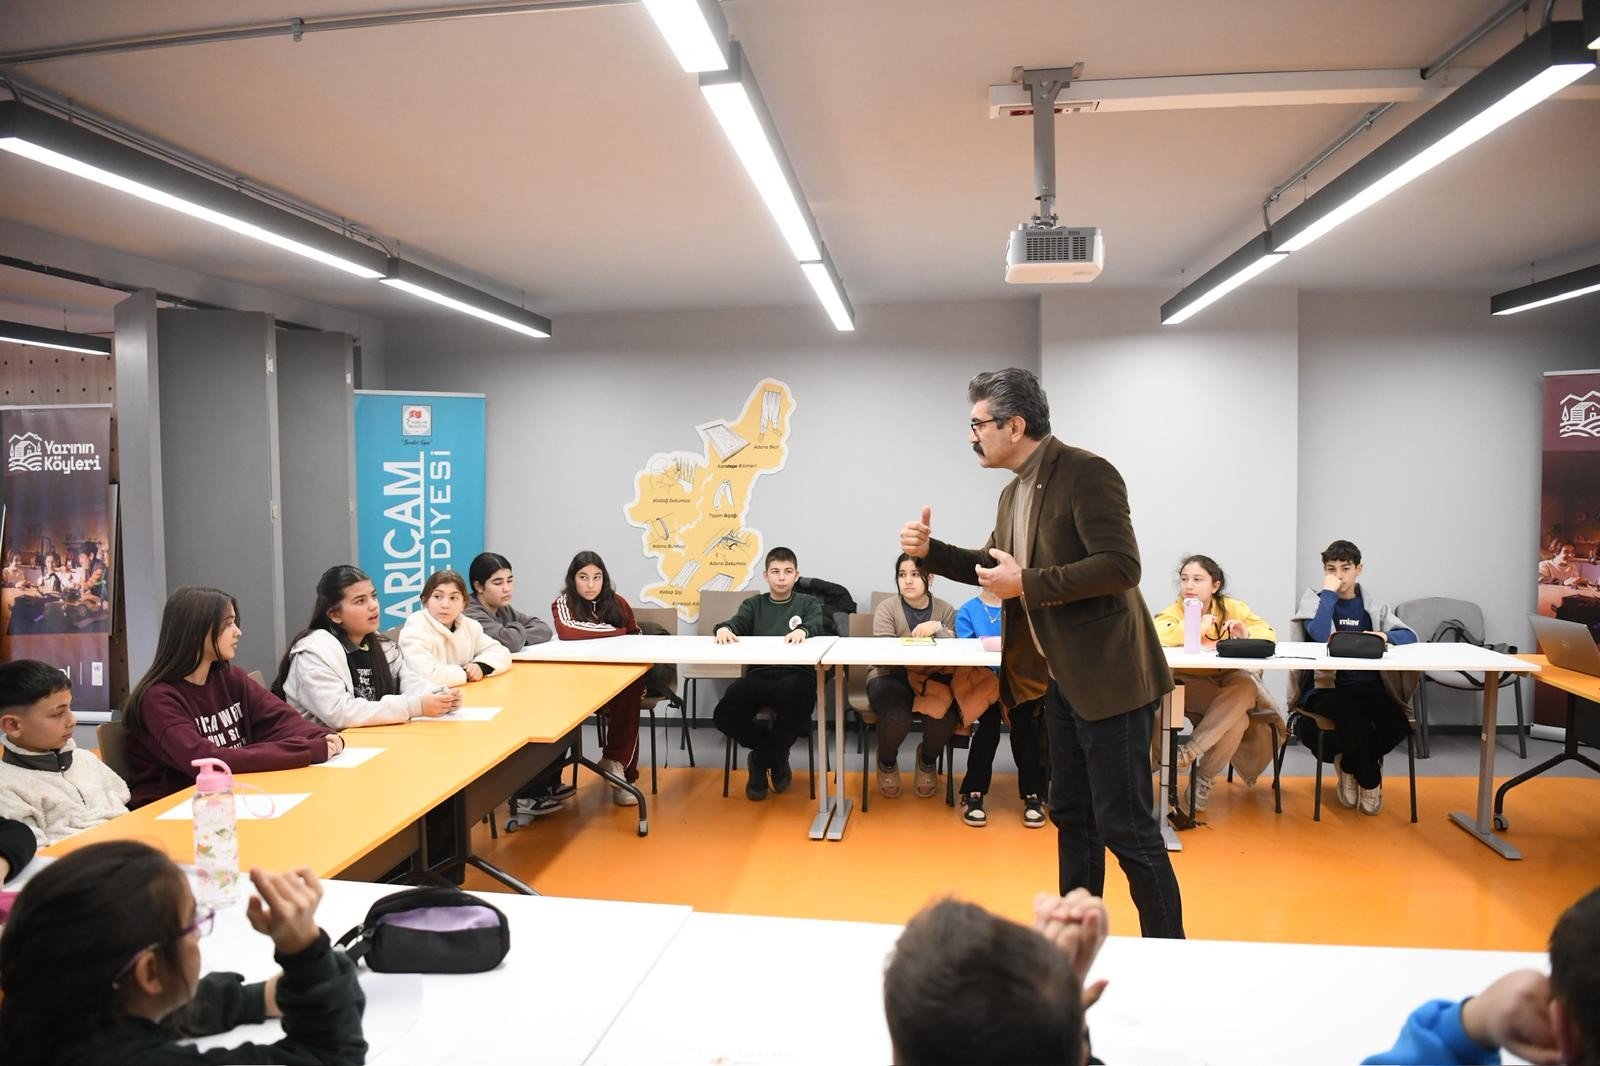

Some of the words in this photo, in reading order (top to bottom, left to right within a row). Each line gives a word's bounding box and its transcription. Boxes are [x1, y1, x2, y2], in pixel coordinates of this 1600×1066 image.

[44, 440, 95, 455] Yarının
[44, 455, 102, 475] Köyleri
[383, 461, 425, 632] ARIÇAM
